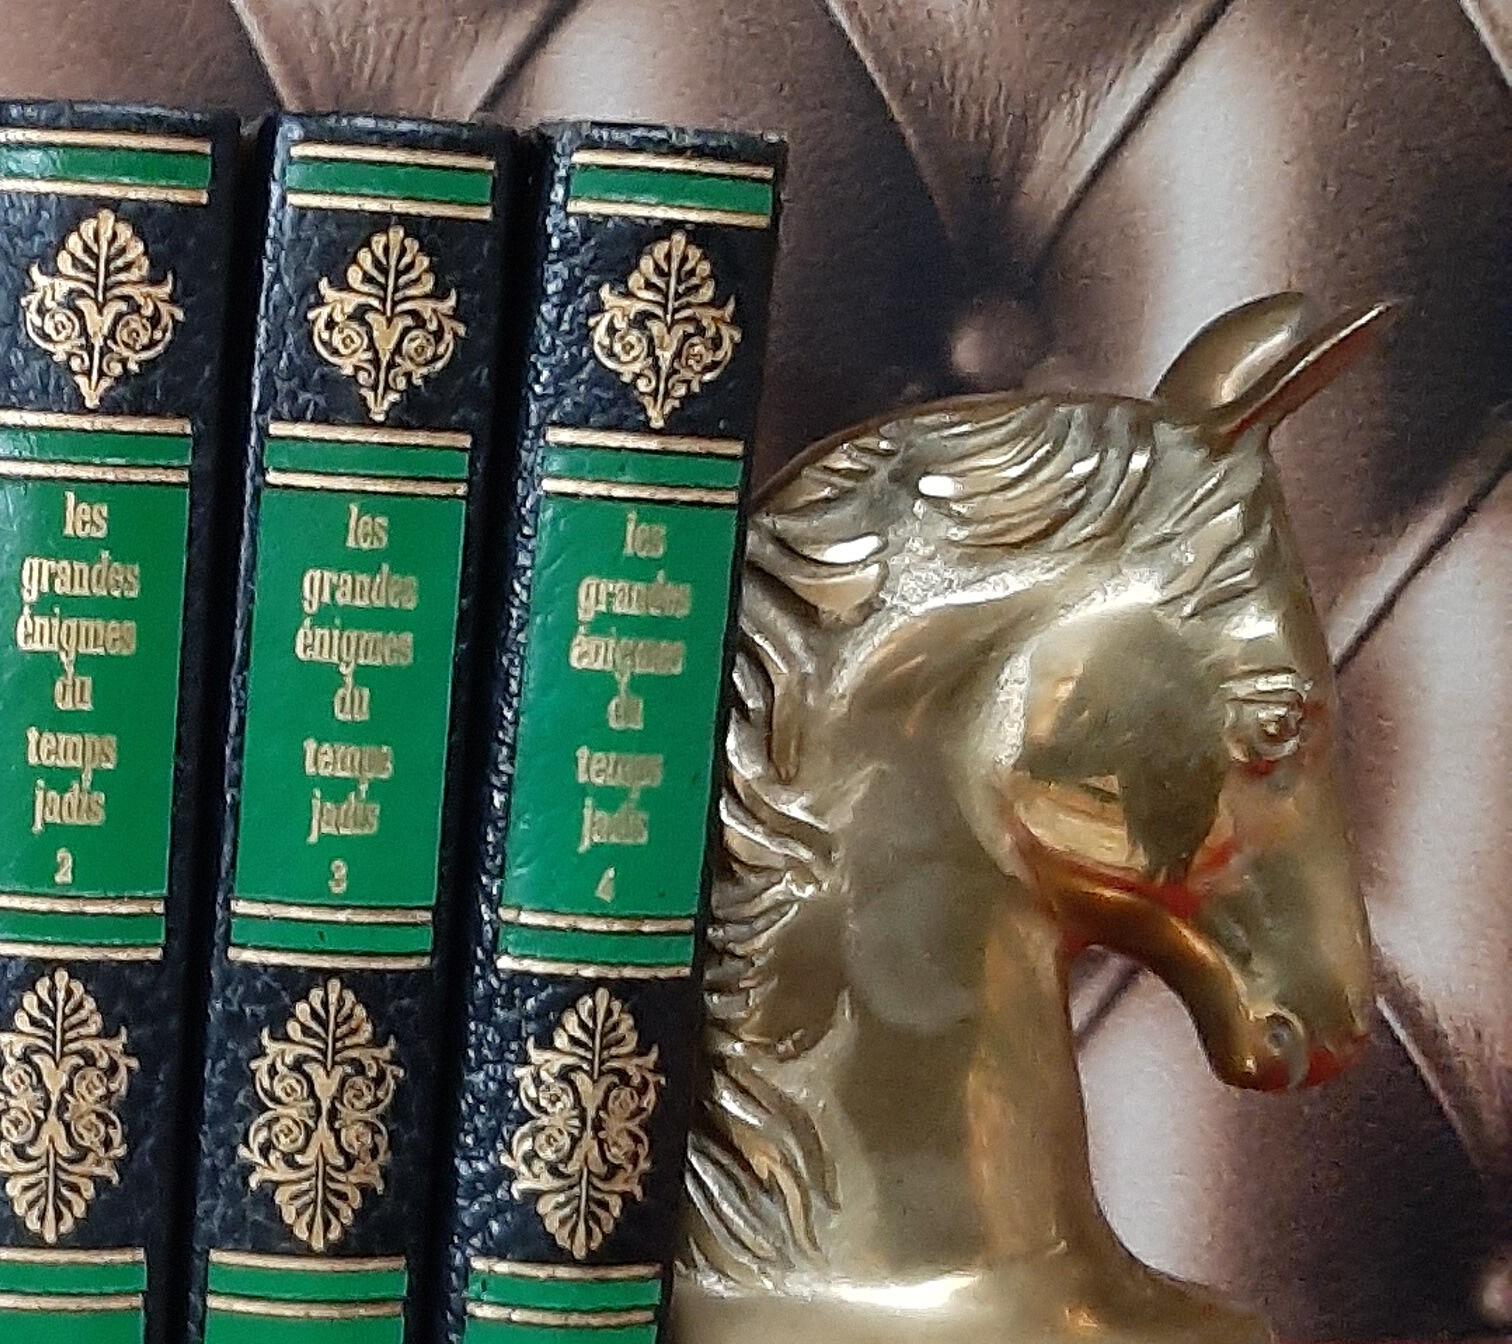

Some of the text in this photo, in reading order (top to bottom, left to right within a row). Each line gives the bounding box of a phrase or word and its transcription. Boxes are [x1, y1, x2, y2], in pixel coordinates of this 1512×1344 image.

[63, 491, 108, 538] les
[346, 503, 388, 550] les
[21, 550, 140, 602] grandes
[302, 562, 417, 615] grandes
[16, 604, 136, 667] énigmes
[55, 665, 93, 711] du
[333, 671, 370, 722] du
[26, 726, 117, 787] temps
[31, 778, 105, 834] jadis
[54, 847, 73, 885] 2
[328, 859, 348, 894] 3
